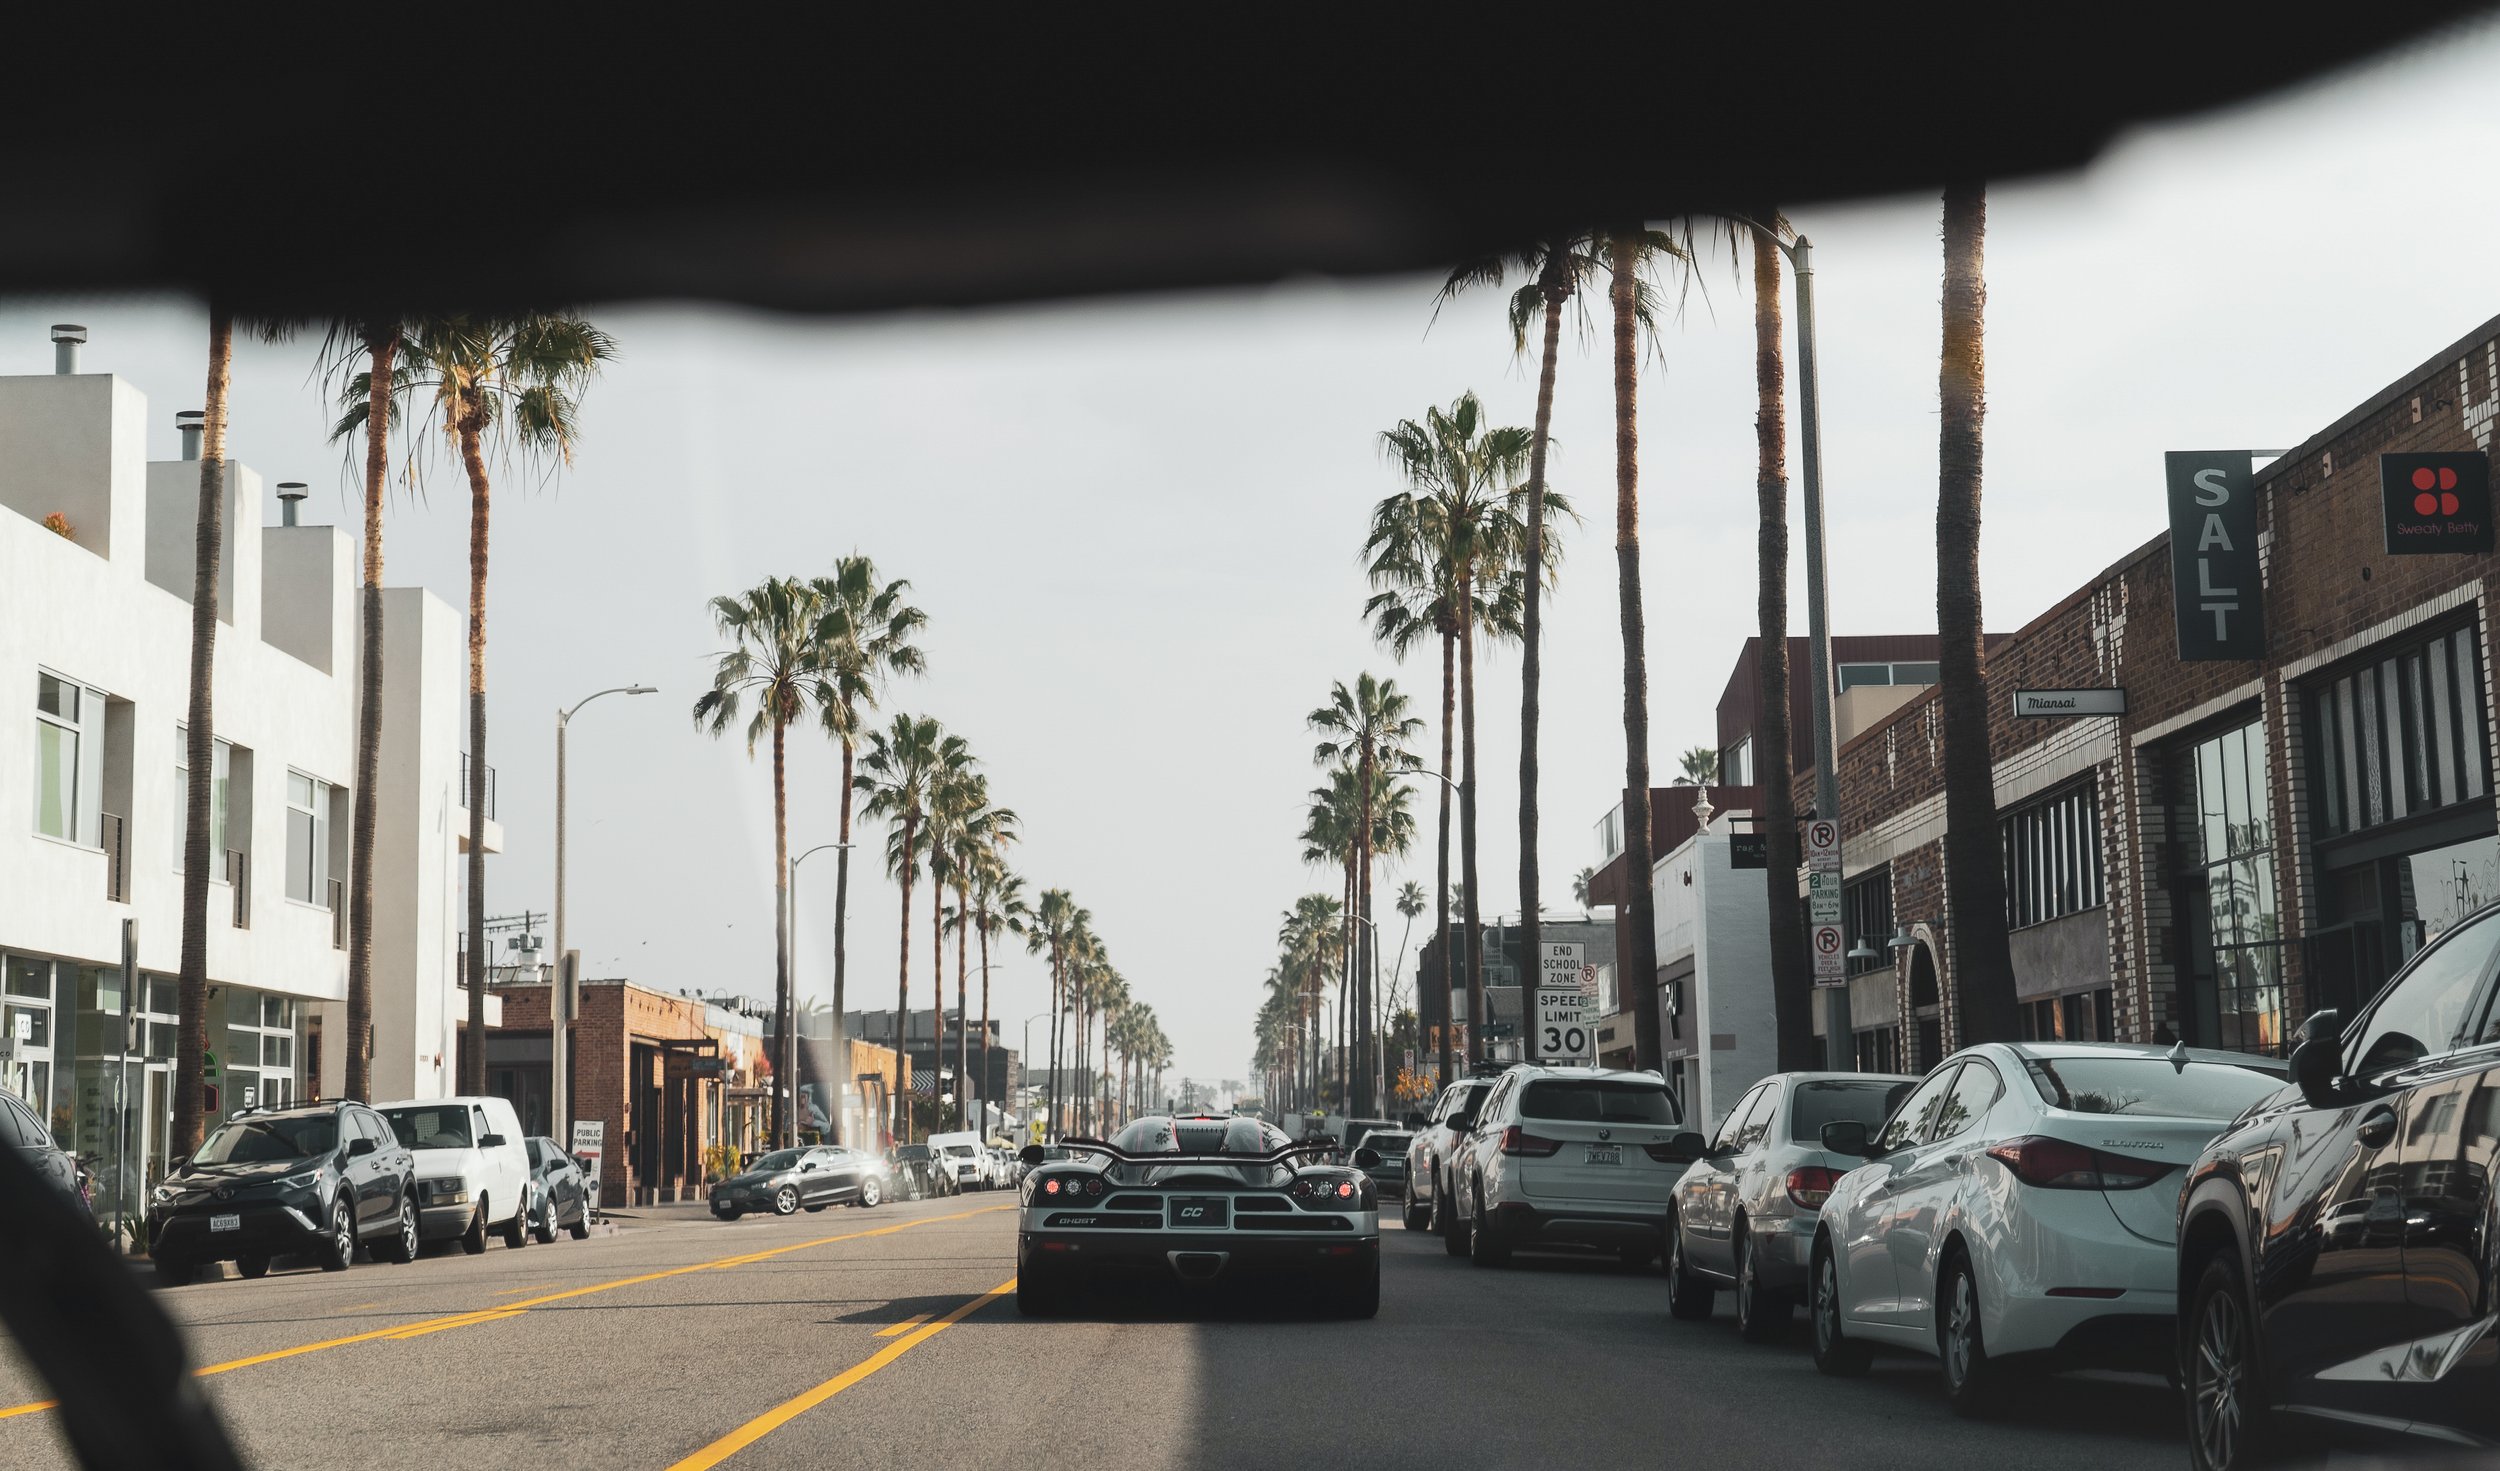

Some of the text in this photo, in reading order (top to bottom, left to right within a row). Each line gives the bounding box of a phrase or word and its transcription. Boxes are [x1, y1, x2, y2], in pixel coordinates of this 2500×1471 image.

[2397, 521, 2479, 536] Sweaty Betty
[2194, 468, 2239, 641] SALT
[2027, 697, 2076, 709] Miansai
[1812, 876, 1837, 887] 2 HOUR
[1812, 889, 1838, 899] PARKING
[1553, 946, 1572, 956] END
[1543, 960, 1582, 970] SCHOOL
[1550, 973, 1576, 983] ZONE
[1545, 1011, 1581, 1022] LIMIT
[1542, 1027, 1585, 1053] 30
[576, 1129, 600, 1137] PUBLIC
[573, 1138, 602, 1147] PARKING
[2100, 1139, 2163, 1149] ELANTRA
